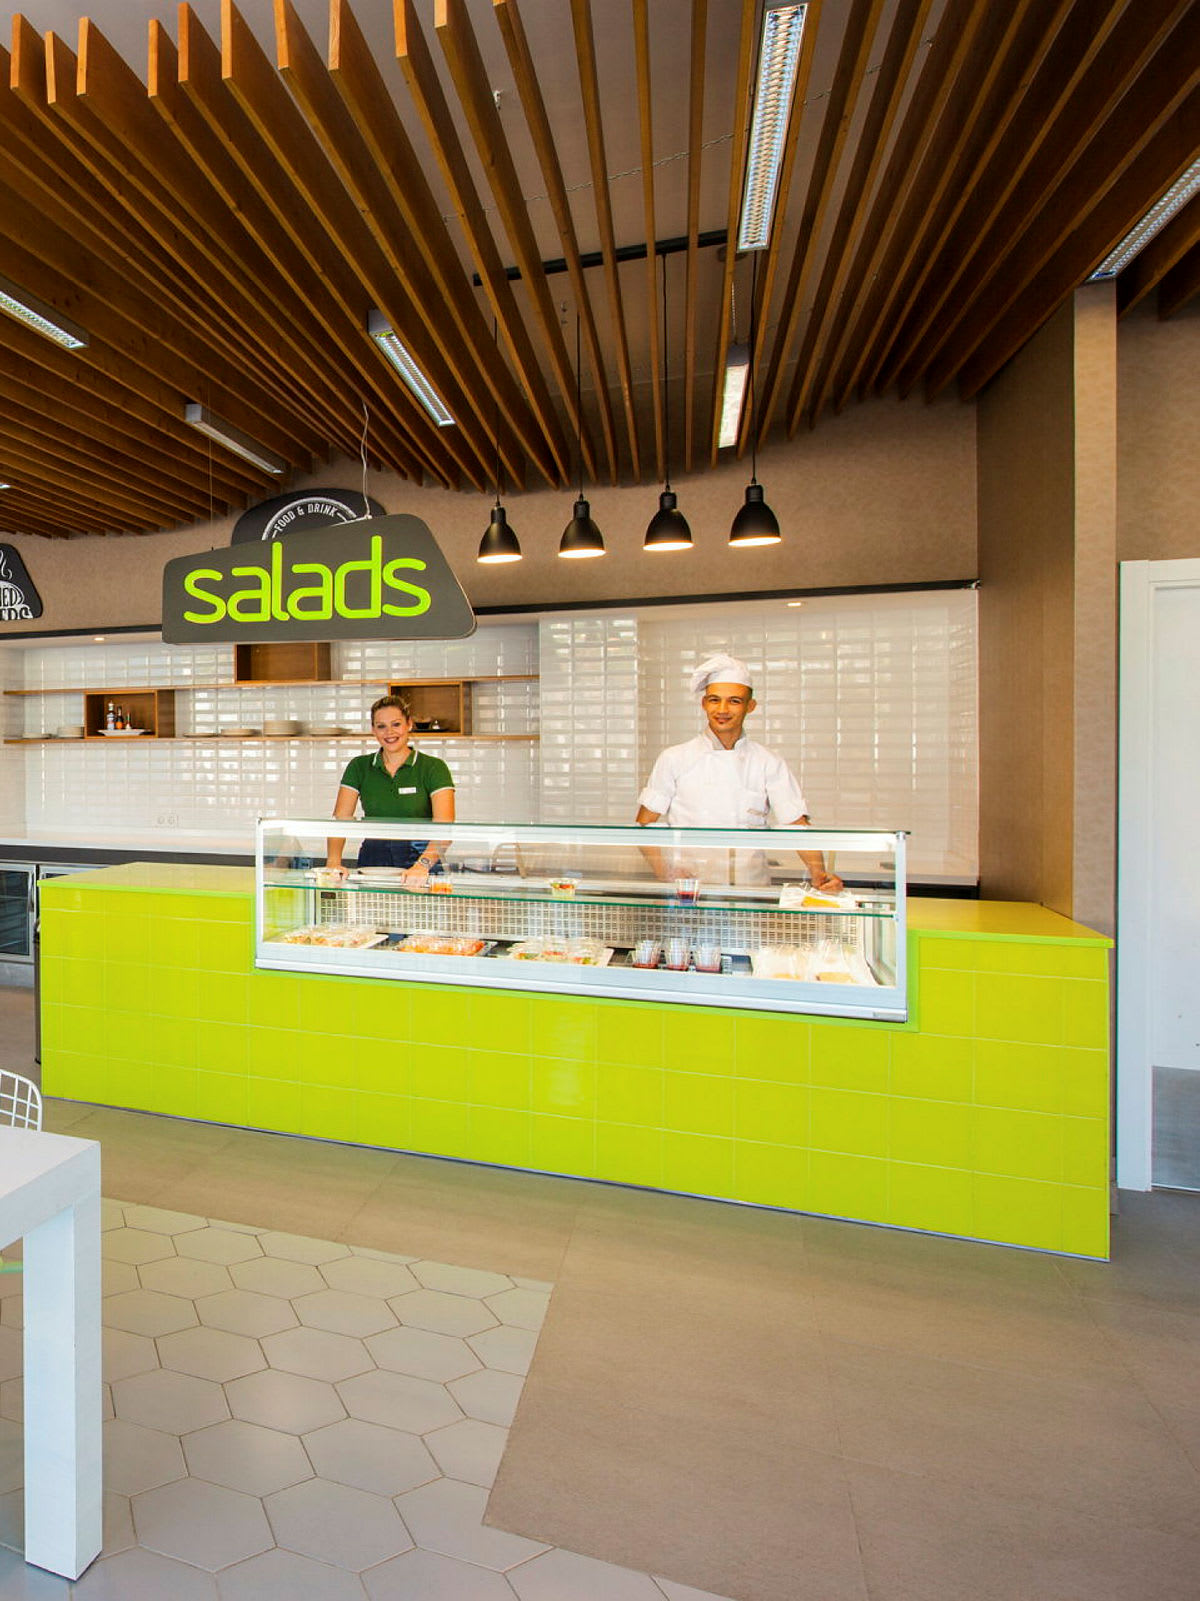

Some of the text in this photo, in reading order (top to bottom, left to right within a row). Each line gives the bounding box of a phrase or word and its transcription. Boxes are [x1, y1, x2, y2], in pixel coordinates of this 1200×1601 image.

[274, 503, 338, 532] FOOD & DRINK
[183, 535, 431, 624] salads
